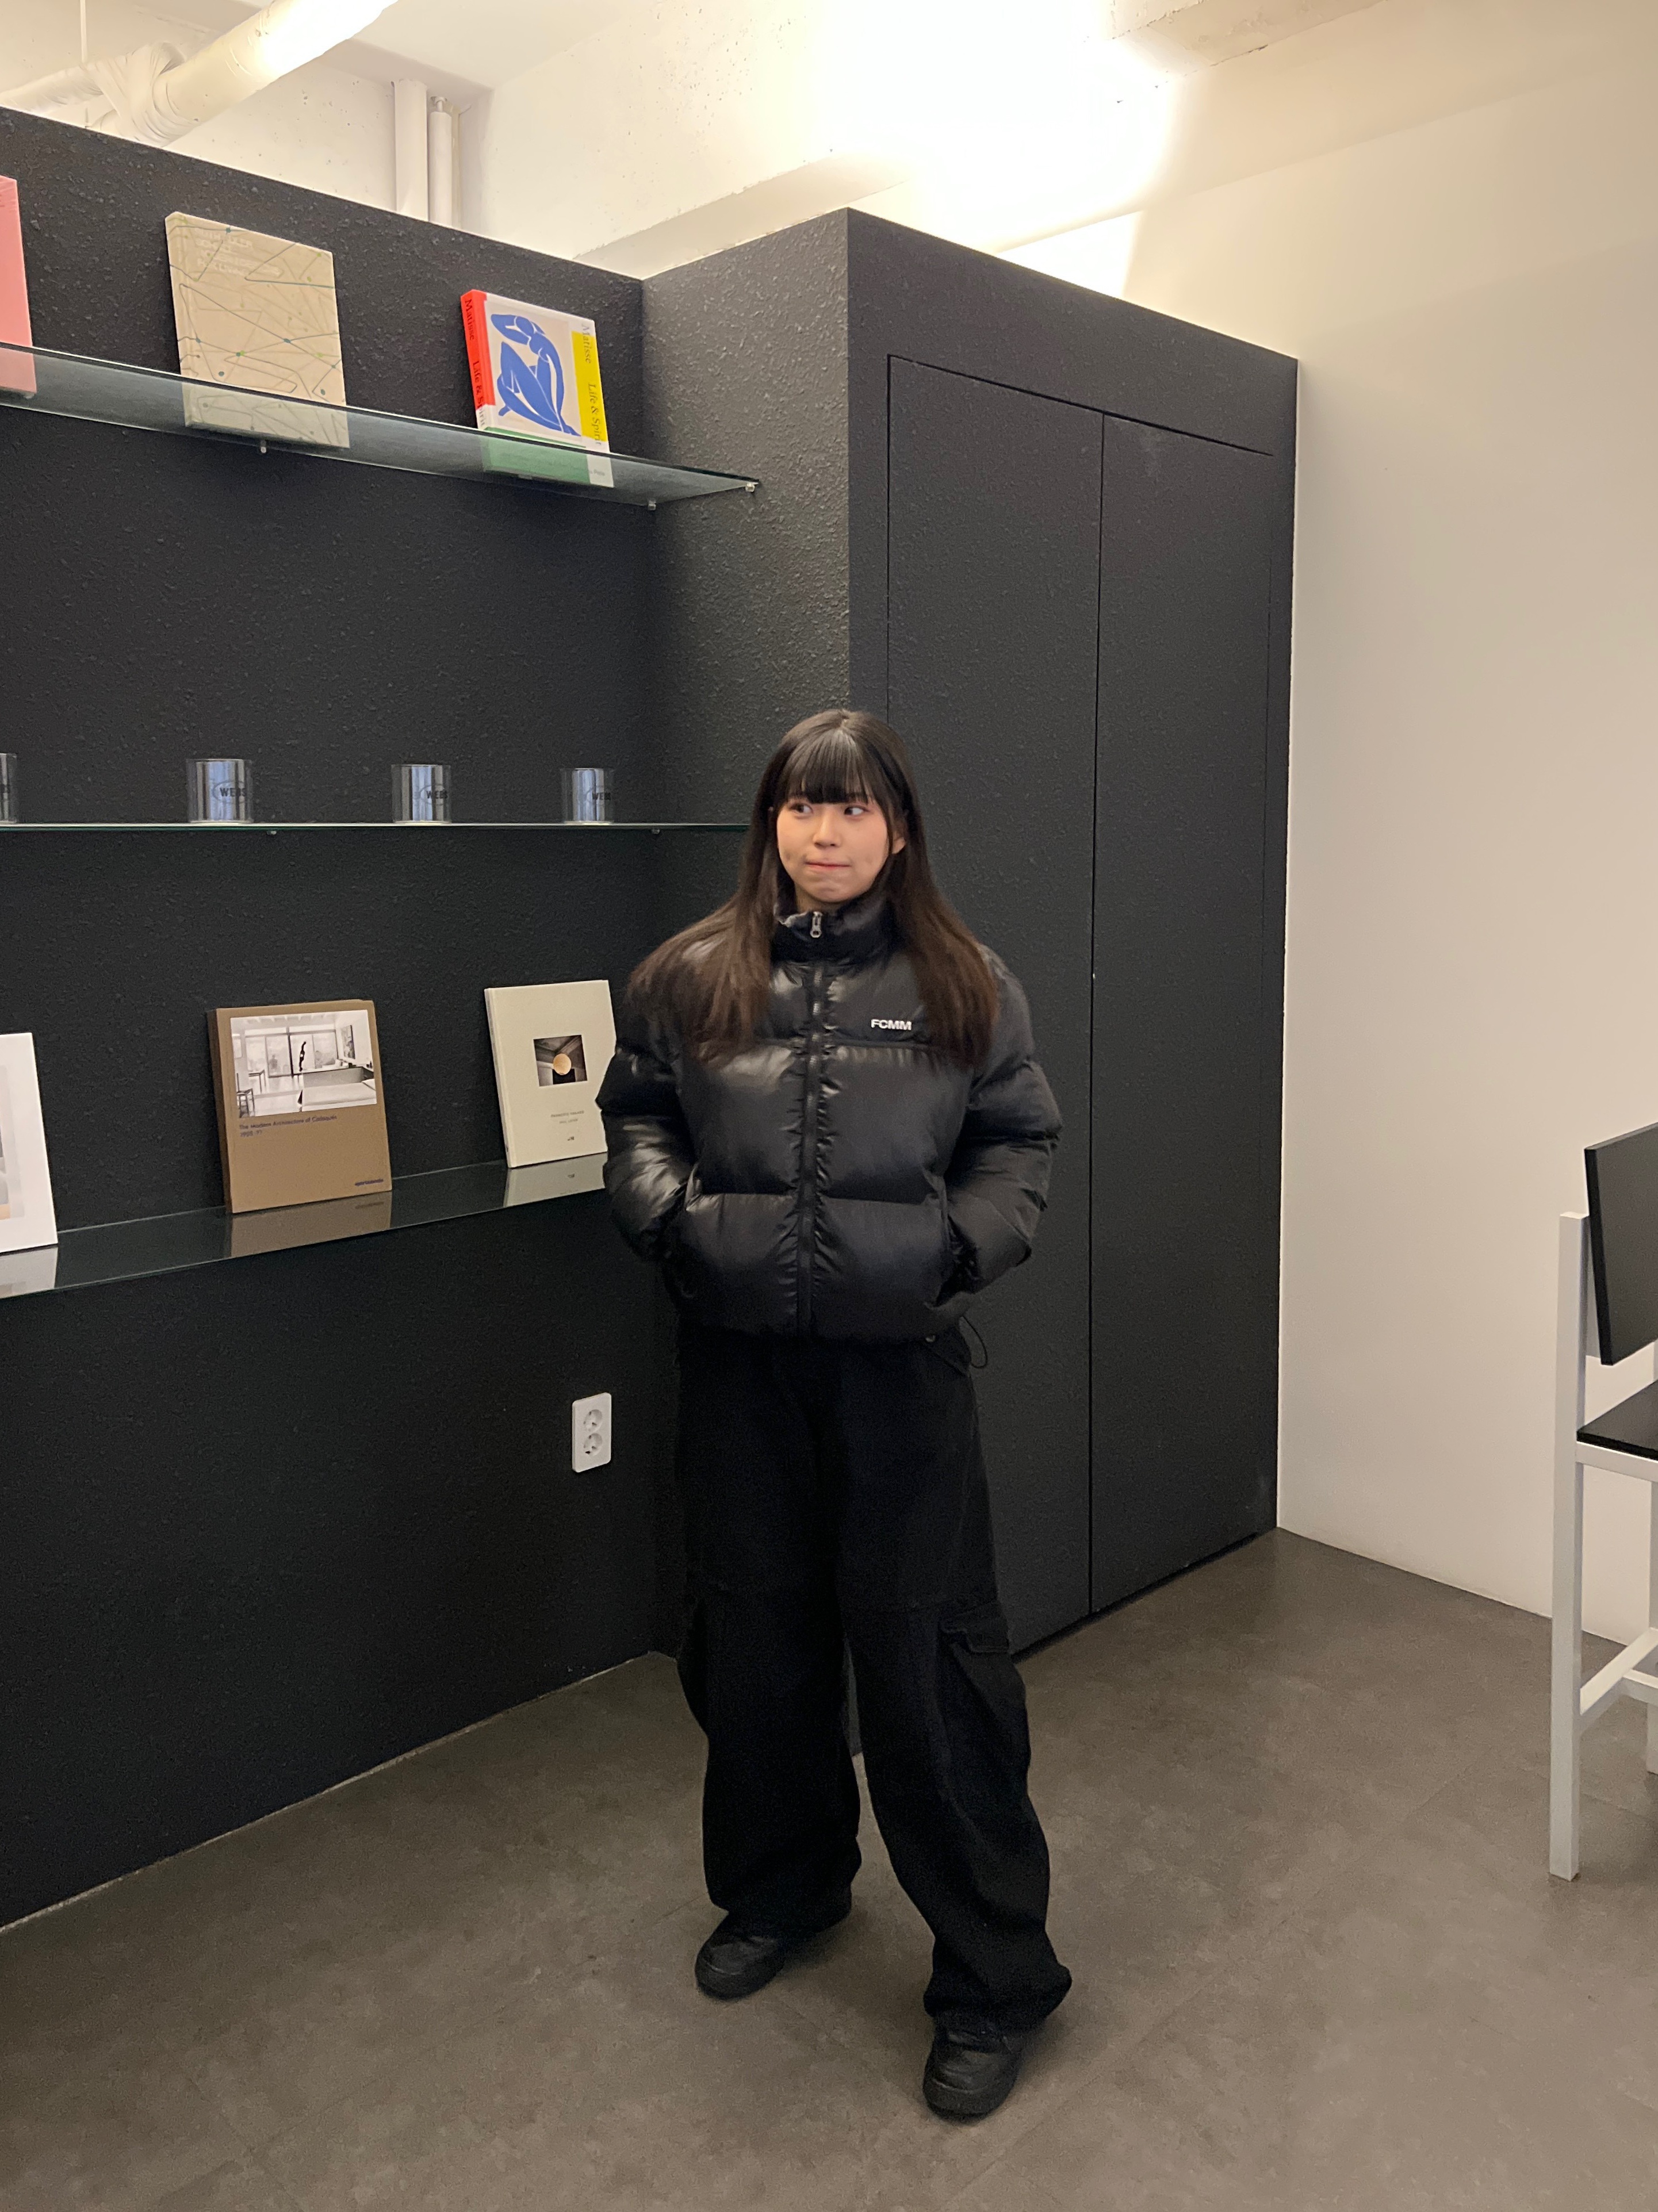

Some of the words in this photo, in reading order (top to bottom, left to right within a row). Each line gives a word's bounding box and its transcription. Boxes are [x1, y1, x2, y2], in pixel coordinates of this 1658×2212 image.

[465, 298, 474, 340] Matisse
[581, 323, 592, 364] Matisse
[473, 361, 481, 384] Life
[476, 385, 483, 396] &
[588, 384, 598, 402] Life
[477, 396, 485, 427] Spirit
[591, 406, 599, 414] &
[591, 417, 602, 445] Spirit
[871, 1018, 912, 1031] FCMM
